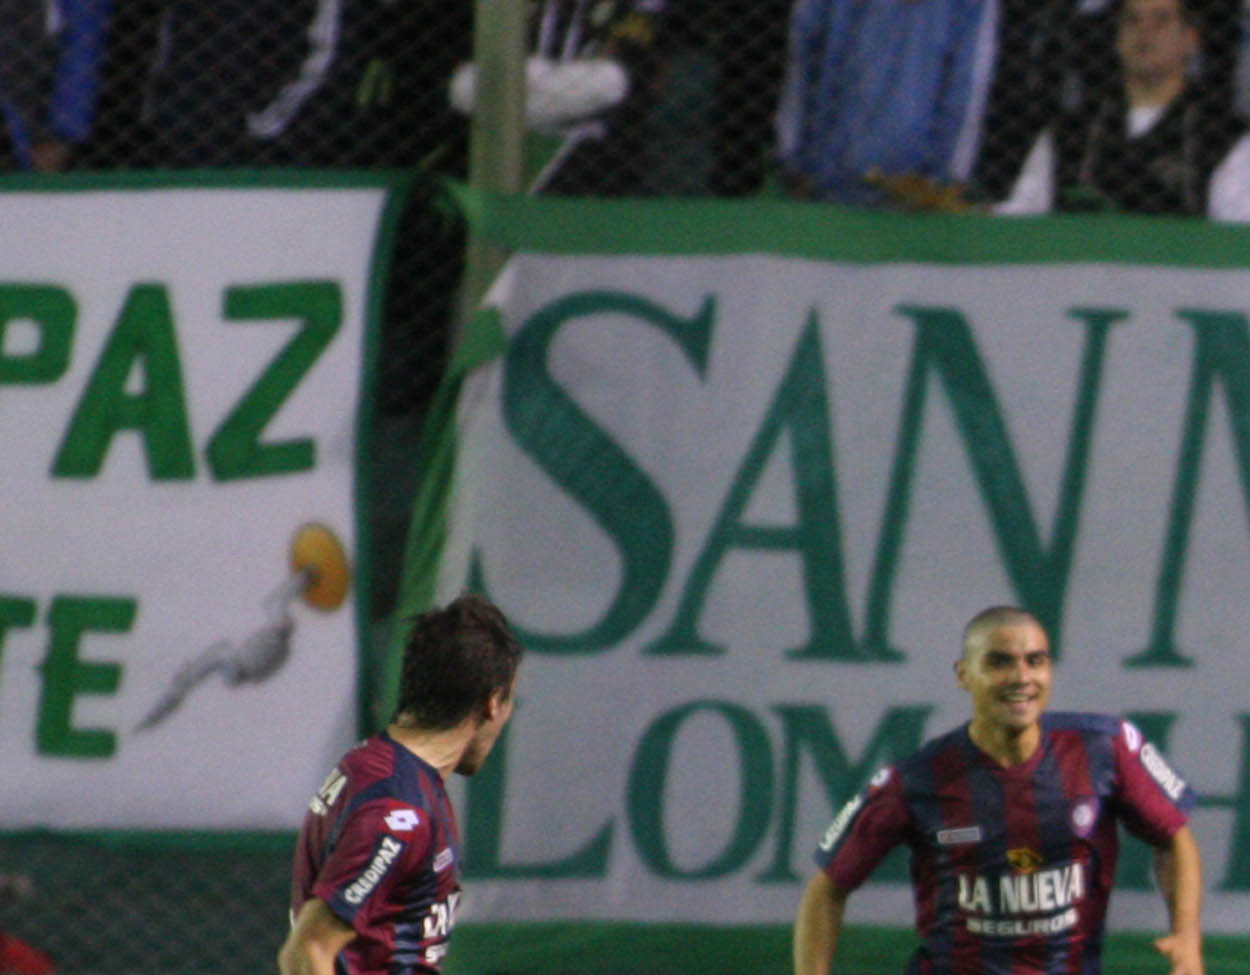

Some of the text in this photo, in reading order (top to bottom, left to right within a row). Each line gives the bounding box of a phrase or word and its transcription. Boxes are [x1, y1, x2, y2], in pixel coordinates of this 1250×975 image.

[0, 279, 344, 482] PAZ
[467, 288, 1131, 667] SAN
[457, 698, 936, 885] LOM
[957, 862, 1084, 914] LA NUEVA
[965, 908, 1079, 935] SEGUROS
